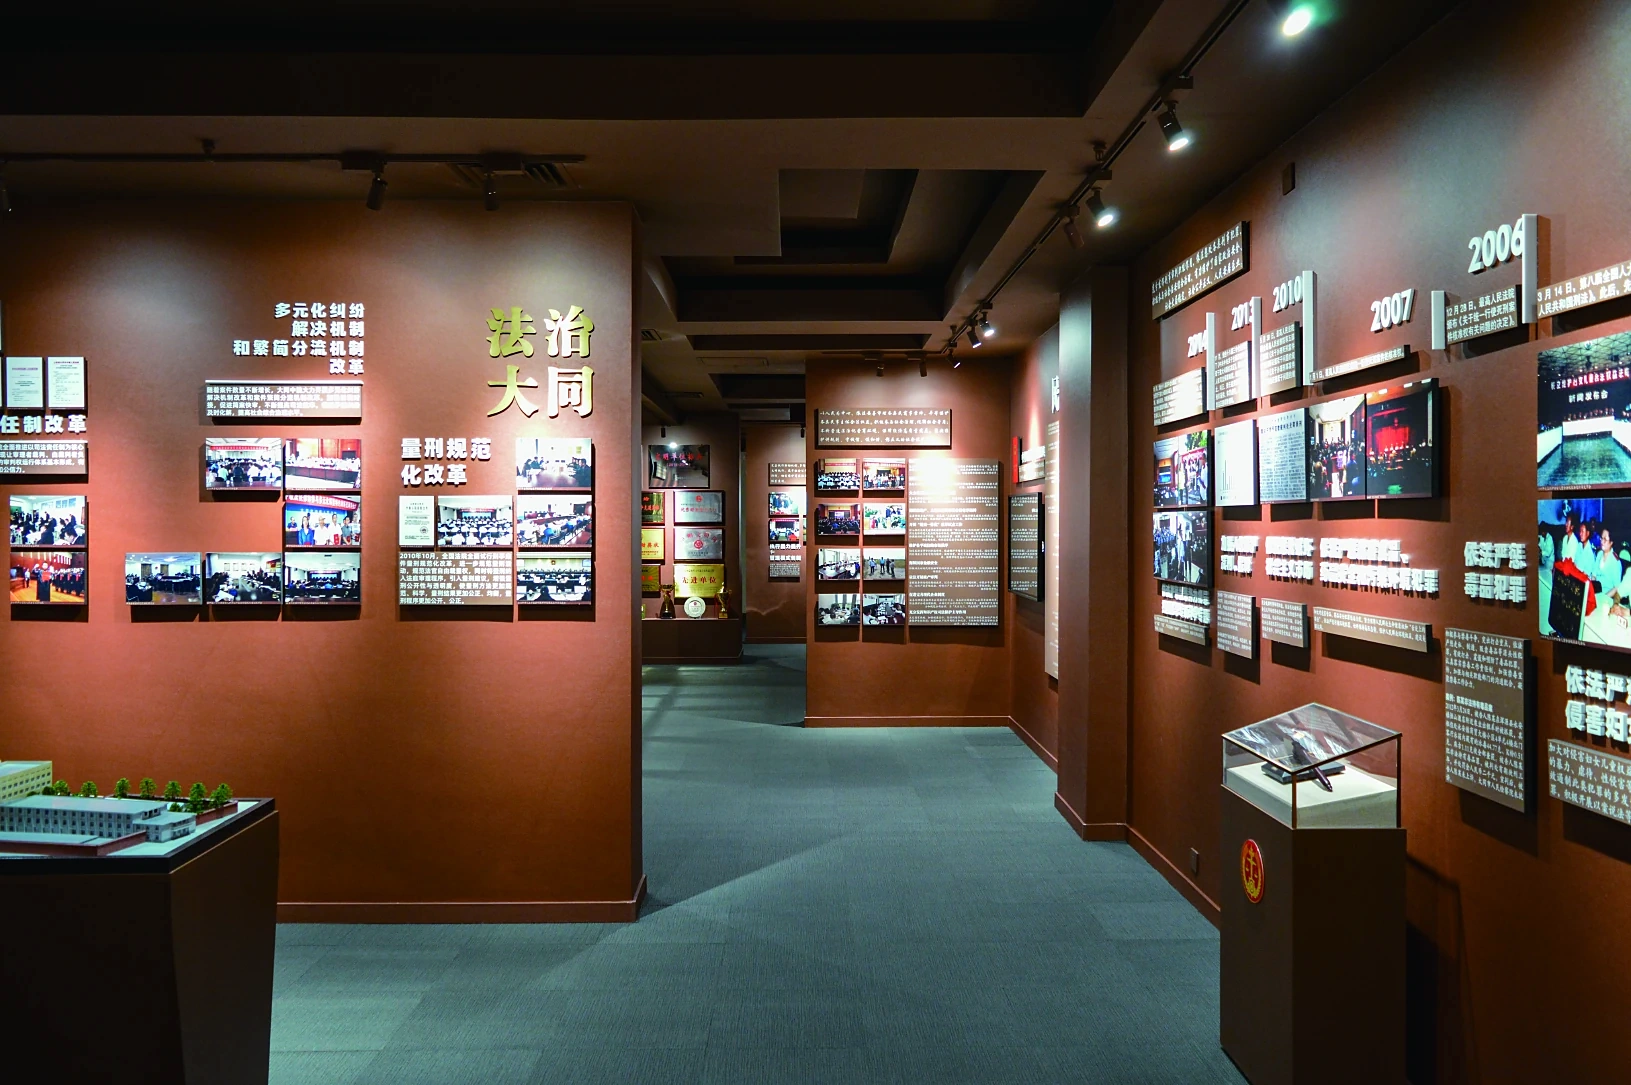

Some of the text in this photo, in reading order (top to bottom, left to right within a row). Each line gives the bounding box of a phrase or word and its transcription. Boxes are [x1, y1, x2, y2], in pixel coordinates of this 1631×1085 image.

[274, 302, 365, 319] 多元化纠纷
[1370, 289, 1414, 332] 2007
[291, 321, 365, 337] 解决机制
[486, 305, 595, 358] 法治
[233, 340, 365, 357] 和繁简分流机制
[329, 358, 365, 375] 改革
[487, 365, 595, 418] 大同
[0, 414, 87, 434] 任制改革
[401, 437, 492, 460] 量刑规范
[401, 464, 468, 486] 化改革
[1464, 541, 1526, 570] 依法严惩
[1463, 571, 1527, 603] 毒品犯罪
[1565, 664, 1631, 704] 依法严
